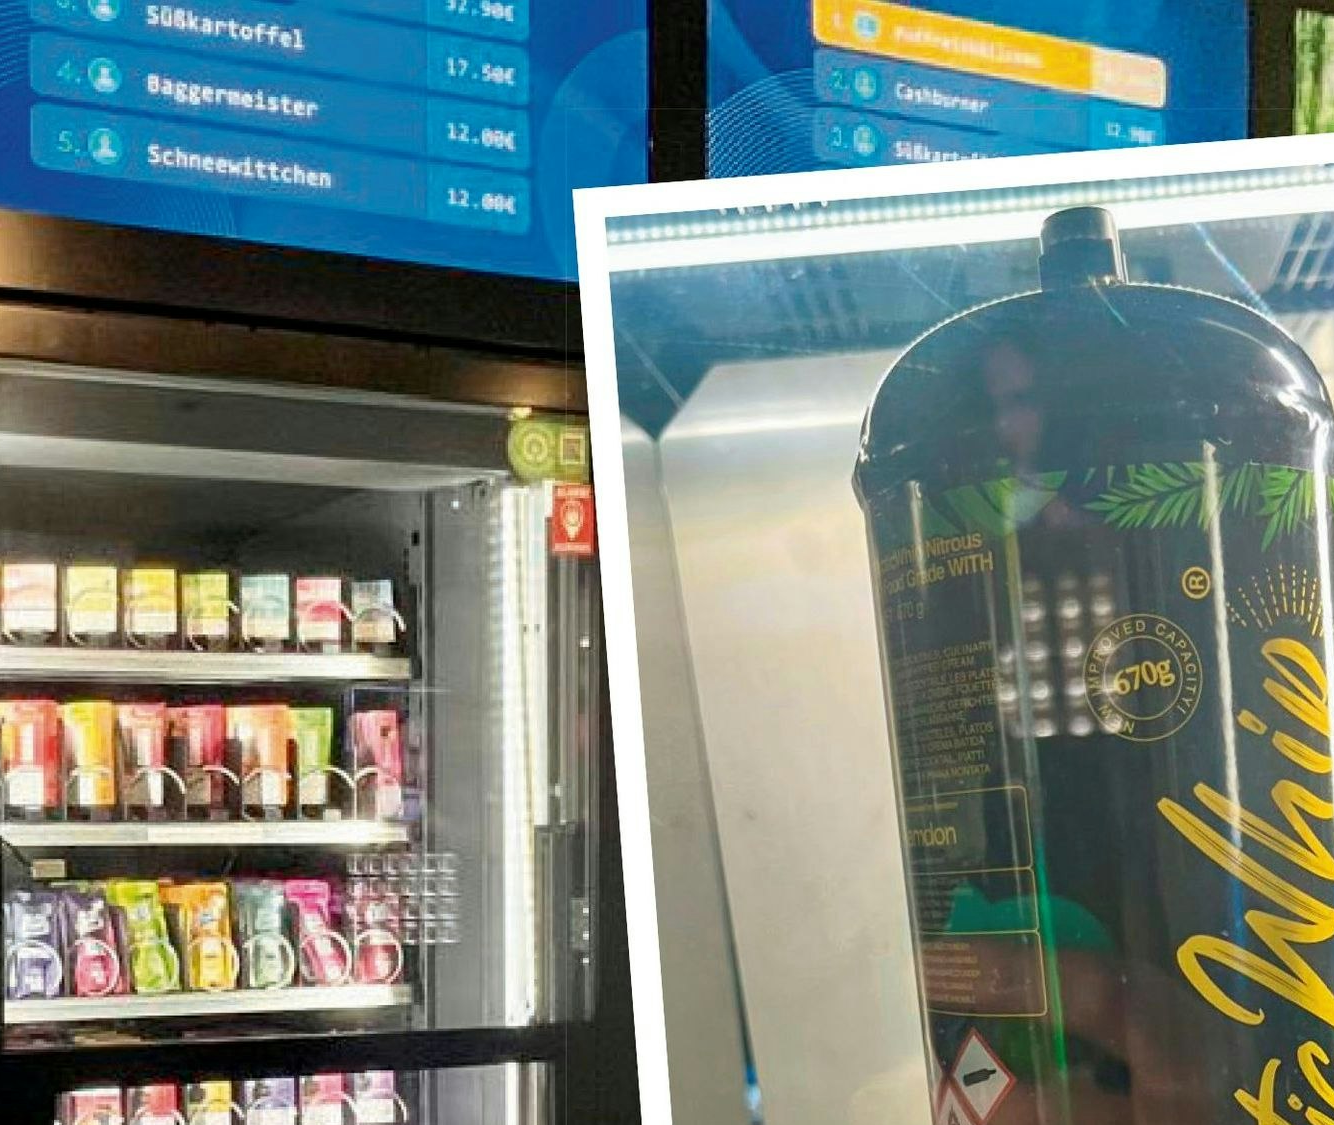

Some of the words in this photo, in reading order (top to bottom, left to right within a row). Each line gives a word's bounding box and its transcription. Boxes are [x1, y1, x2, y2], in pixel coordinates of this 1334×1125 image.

[146, 4, 306, 51] Süßkartoffel
[146, 73, 320, 118] Baggermeister
[146, 143, 333, 190] Schneewittchen
[925, 532, 983, 559] Nitrous
[947, 550, 995, 578] WITH
[1088, 620, 1146, 698] IMPROVED
[1112, 658, 1177, 697] 670g
[1097, 702, 1136, 735] NW
